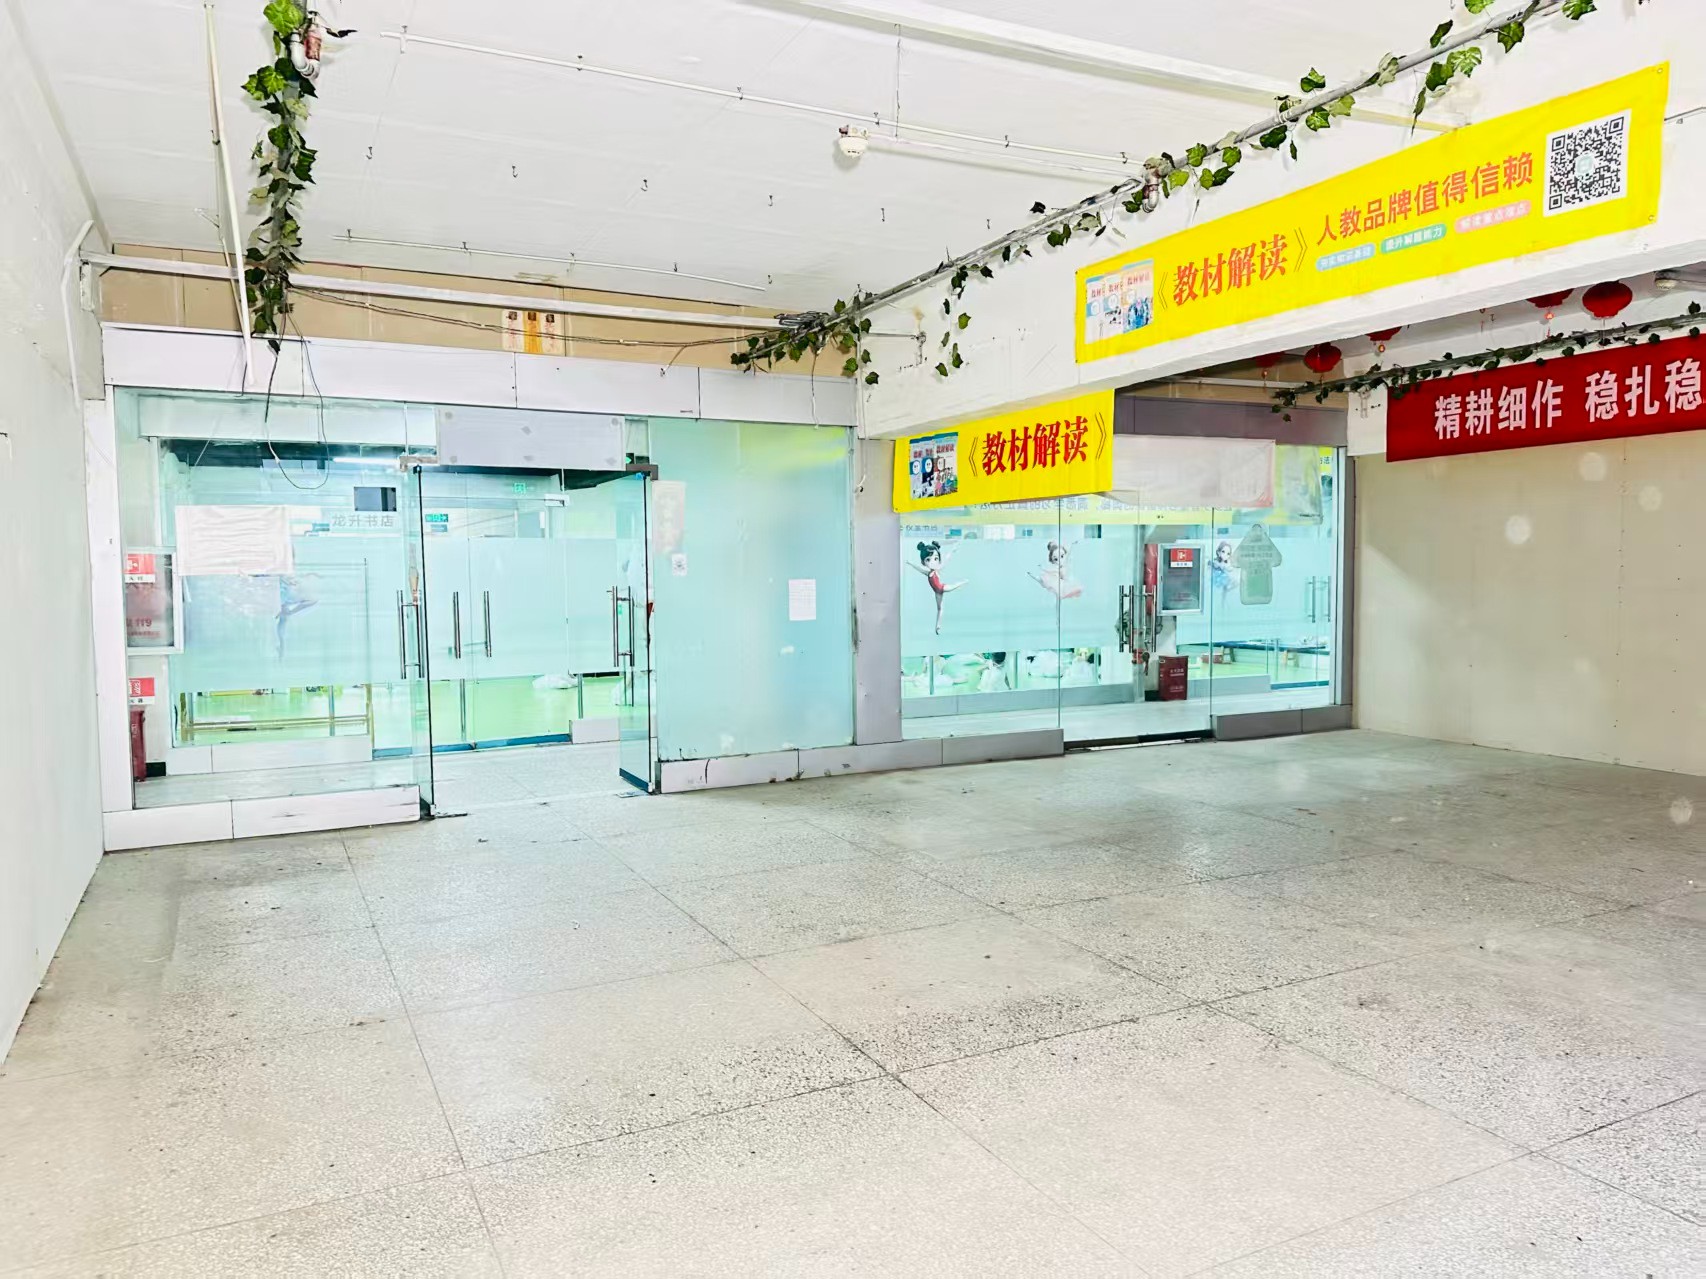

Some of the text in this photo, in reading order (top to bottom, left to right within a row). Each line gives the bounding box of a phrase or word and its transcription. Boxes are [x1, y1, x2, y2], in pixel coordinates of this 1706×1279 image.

[1317, 151, 1534, 246] 人教品牌值得信赖
[1157, 230, 1311, 309] 《教材解读》
[1434, 358, 1703, 440] 精耕细作 稳扎稳
[969, 412, 1107, 477] 《教材解读》
